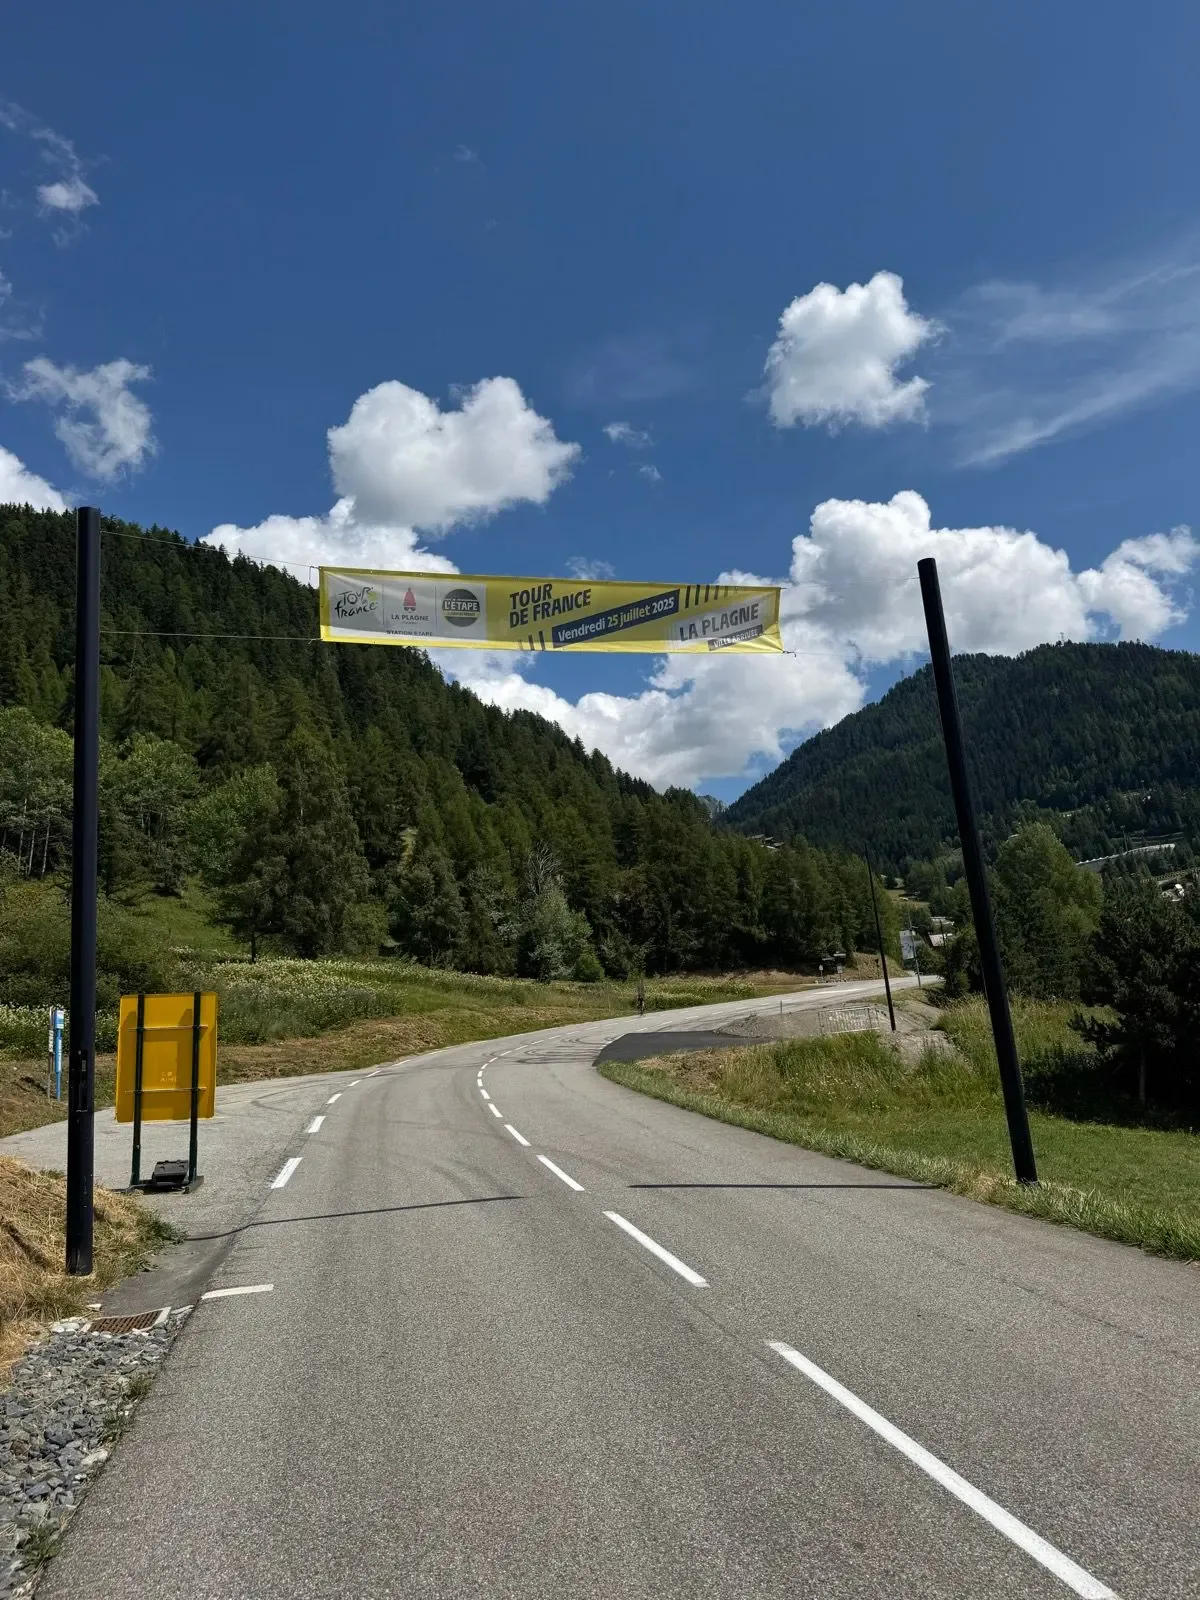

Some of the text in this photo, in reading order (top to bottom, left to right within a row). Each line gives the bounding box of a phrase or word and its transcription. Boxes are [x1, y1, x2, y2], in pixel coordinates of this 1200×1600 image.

[510, 583, 552, 609] TOUR
[510, 588, 591, 628] DE FRANCE
[558, 596, 675, 642] Vendredi 25 juillet 2025
[679, 603, 759, 642] LA PLAGNE
